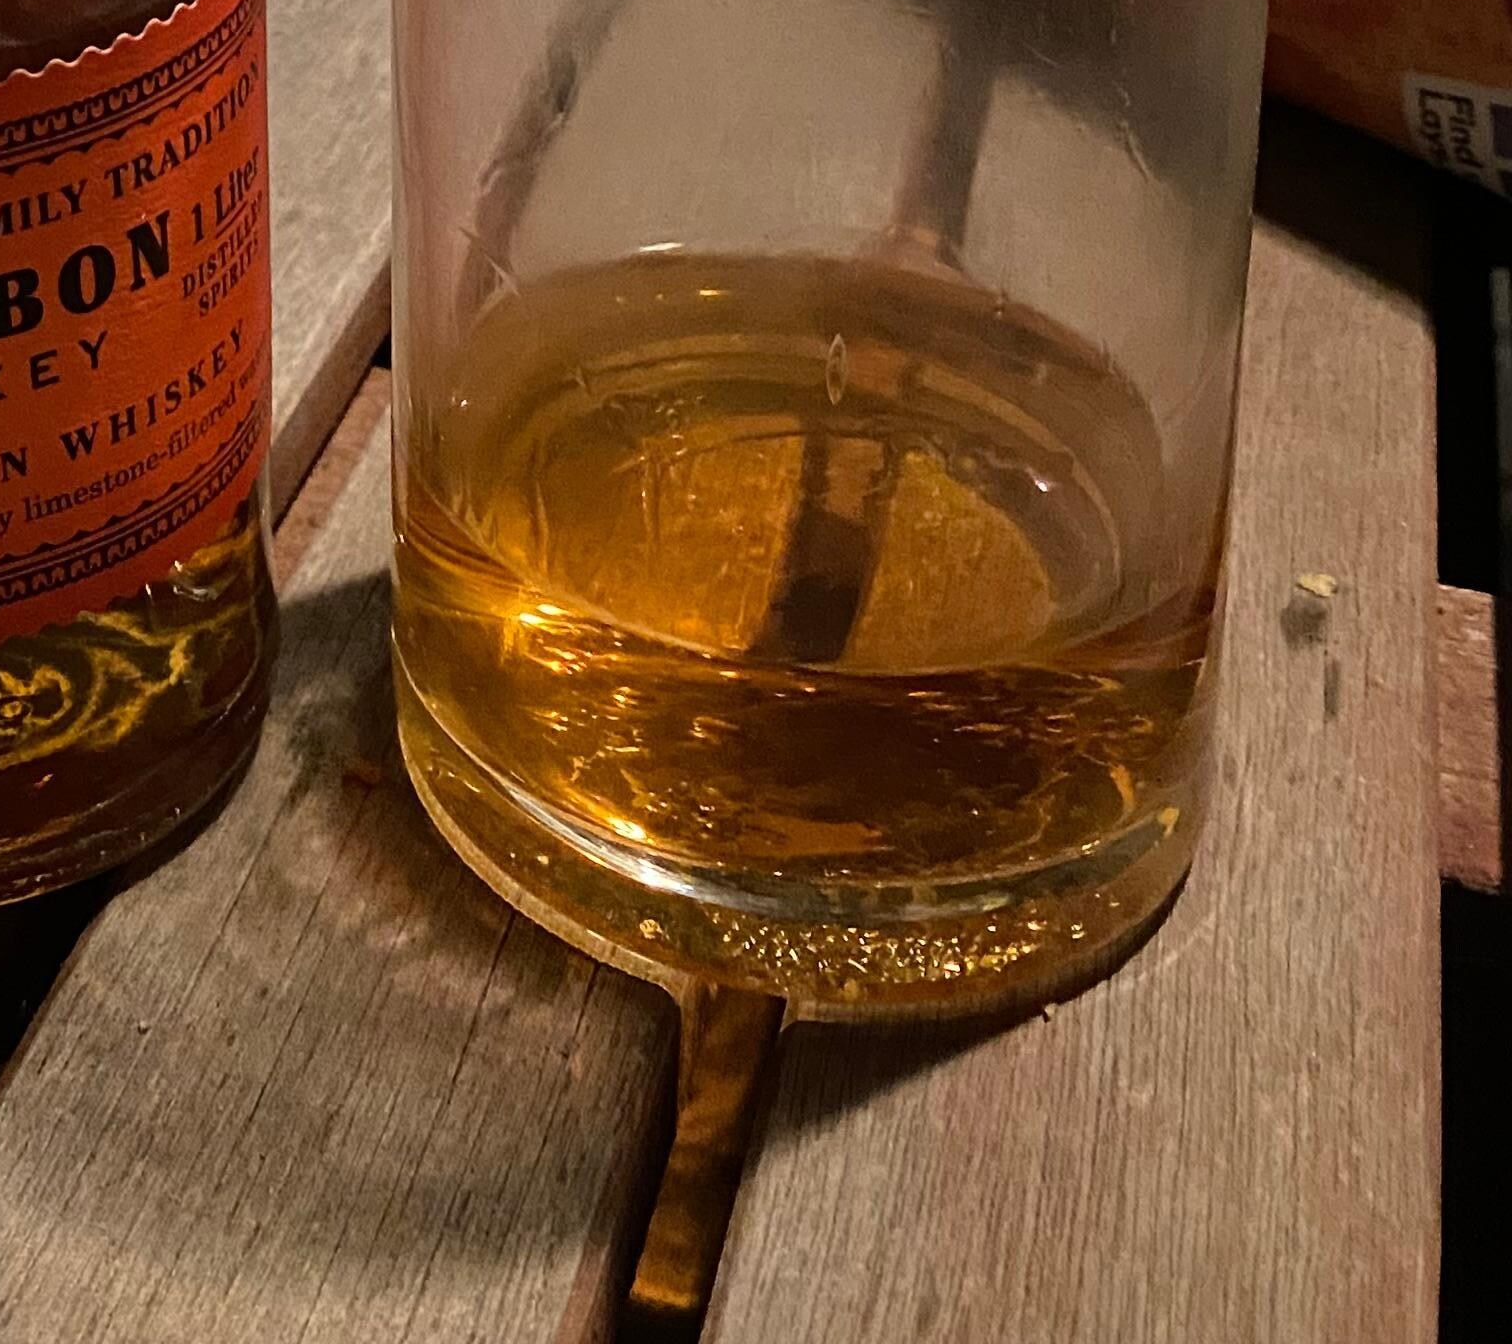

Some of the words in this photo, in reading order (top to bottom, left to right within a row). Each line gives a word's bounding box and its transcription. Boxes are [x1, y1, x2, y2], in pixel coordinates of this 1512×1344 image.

[105, 54, 260, 198] TRADITION
[190, 201, 206, 246] 1
[213, 144, 261, 227] Liter
[22, 380, 237, 516] limestone-filtered
[60, 318, 245, 463] WHISKEY
